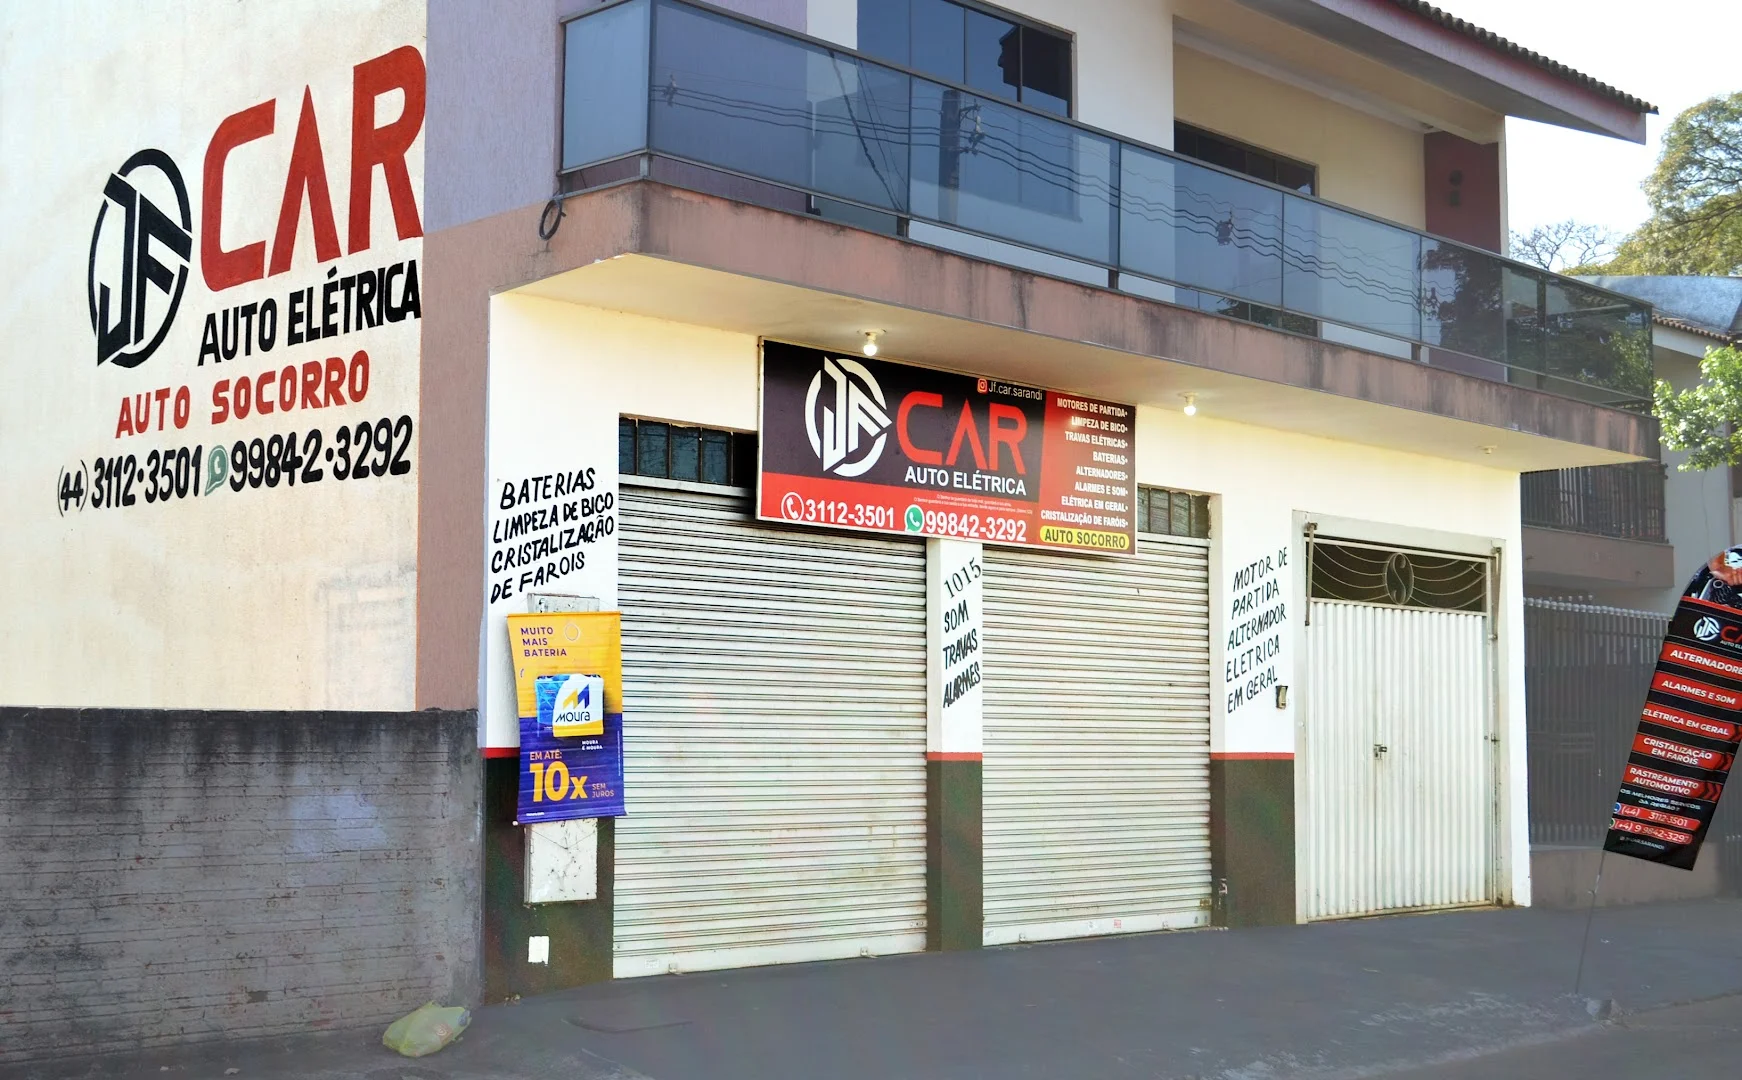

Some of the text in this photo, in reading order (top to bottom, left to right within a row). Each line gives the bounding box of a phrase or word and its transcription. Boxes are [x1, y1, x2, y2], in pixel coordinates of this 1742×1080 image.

[201, 45, 426, 292] CAR
[197, 260, 421, 367] AUTO ELÉTRICA
[115, 350, 370, 439] AUTO SOCORRO
[1057, 398, 1088, 411] MOTORES
[1089, 402, 1098, 413] DE
[896, 391, 1028, 475] CAR
[1065, 431, 1090, 443] TRAVAS
[1071, 415, 1099, 429] LIMPEZA
[1100, 420, 1109, 431] DE
[57, 459, 89, 518] (44)
[500, 467, 596, 510] BATERIAS
[904, 465, 1027, 496] AUTO ELÉTRICA
[1074, 482, 1105, 494] ALARMES
[1106, 485, 1111, 495] E
[493, 492, 614, 543] LIMPEZA DE BICO
[805, 499, 895, 529] 3112-3501
[1040, 509, 1092, 525] CRISTALIZAÇÃO
[1093, 515, 1102, 525] DE
[1061, 495, 1093, 508] ELÉTRICA
[1094, 499, 1104, 509] EM
[925, 510, 1027, 542] 99842-3292
[1045, 529, 1126, 548] AUTO SOCORRO
[491, 515, 614, 574] CRISTALIZAÇÃO
[491, 551, 585, 604] DE FAROIS
[944, 557, 982, 598] 1015
[1233, 547, 1287, 592] MOTOR DE
[1231, 578, 1280, 620] PARTIDA
[521, 627, 554, 636] MUITO
[944, 600, 969, 633] SOM
[1227, 603, 1286, 651] ALTERNADOR
[522, 638, 548, 646] MAIS
[524, 648, 567, 657] BATERIA
[943, 628, 978, 669] TRAVAS
[1226, 634, 1280, 683] ELETRICA
[943, 661, 981, 708] ALARMES
[1227, 665, 1278, 714] EM GERAL
[1662, 680, 1707, 698] ALARMES
[1715, 693, 1736, 705] SOM
[1642, 708, 1729, 735] ELÉTRICA EM GERAL
[544, 750, 562, 760] ATÉ:
[1643, 737, 1712, 760] CRISTALIZAÇÃO
[1651, 748, 1698, 765] EM FARÓIS
[529, 761, 588, 802] 10x
[1630, 767, 1699, 789] RASTREAMENTO
[1632, 777, 1690, 795] AUTOMOTIVO
[592, 790, 615, 798] JUROS
